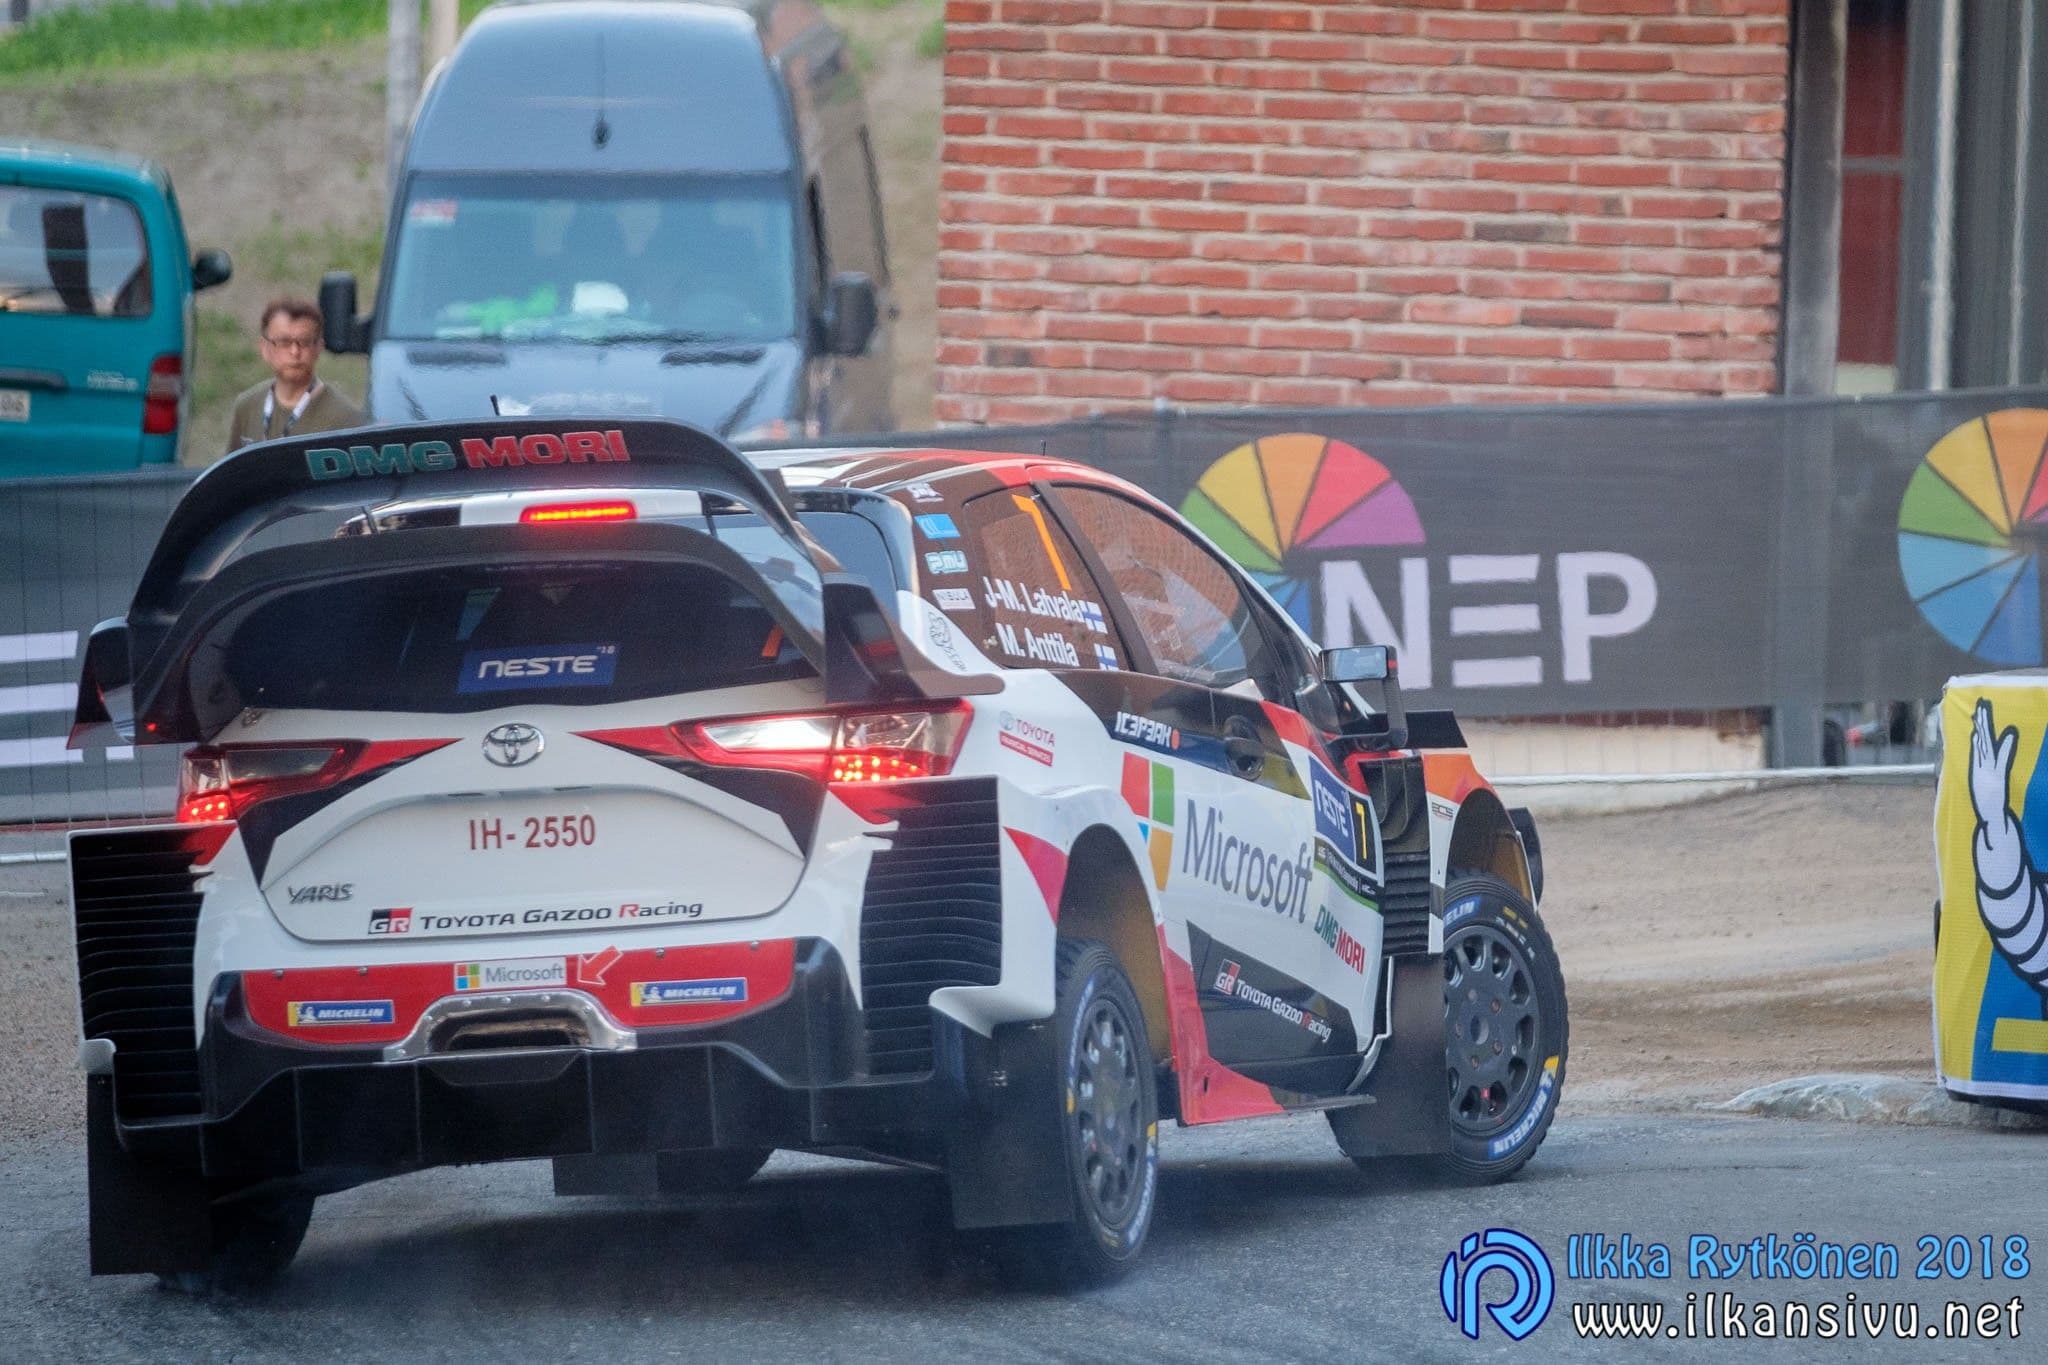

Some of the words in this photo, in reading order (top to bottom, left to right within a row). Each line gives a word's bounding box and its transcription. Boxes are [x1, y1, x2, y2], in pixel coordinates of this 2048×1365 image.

[304, 440, 457, 481] DMG
[460, 429, 631, 470] MORI
[1320, 551, 1658, 691] NEP
[995, 622, 1026, 658] M.
[1024, 627, 1081, 668] Anttila
[477, 654, 599, 679] NESTE
[1015, 718, 1056, 748] TOYOTA
[468, 814, 596, 851] IH-2550
[1182, 799, 1314, 925] Microsoft
[288, 882, 354, 904] YARIS
[420, 913, 516, 932] TOYOTA
[523, 907, 612, 925] GAZOO
[618, 901, 704, 919] Racing
[1313, 904, 1340, 949] DMG
[1335, 927, 1366, 975] MORI
[485, 961, 566, 985] Microsoft
[663, 985, 738, 998] MICHELIN
[317, 1007, 385, 1018] MICHELIN
[1236, 979, 1273, 1010] TOYOTA
[1271, 996, 1304, 1025] GAZOO
[1302, 1011, 1333, 1044] Racing
